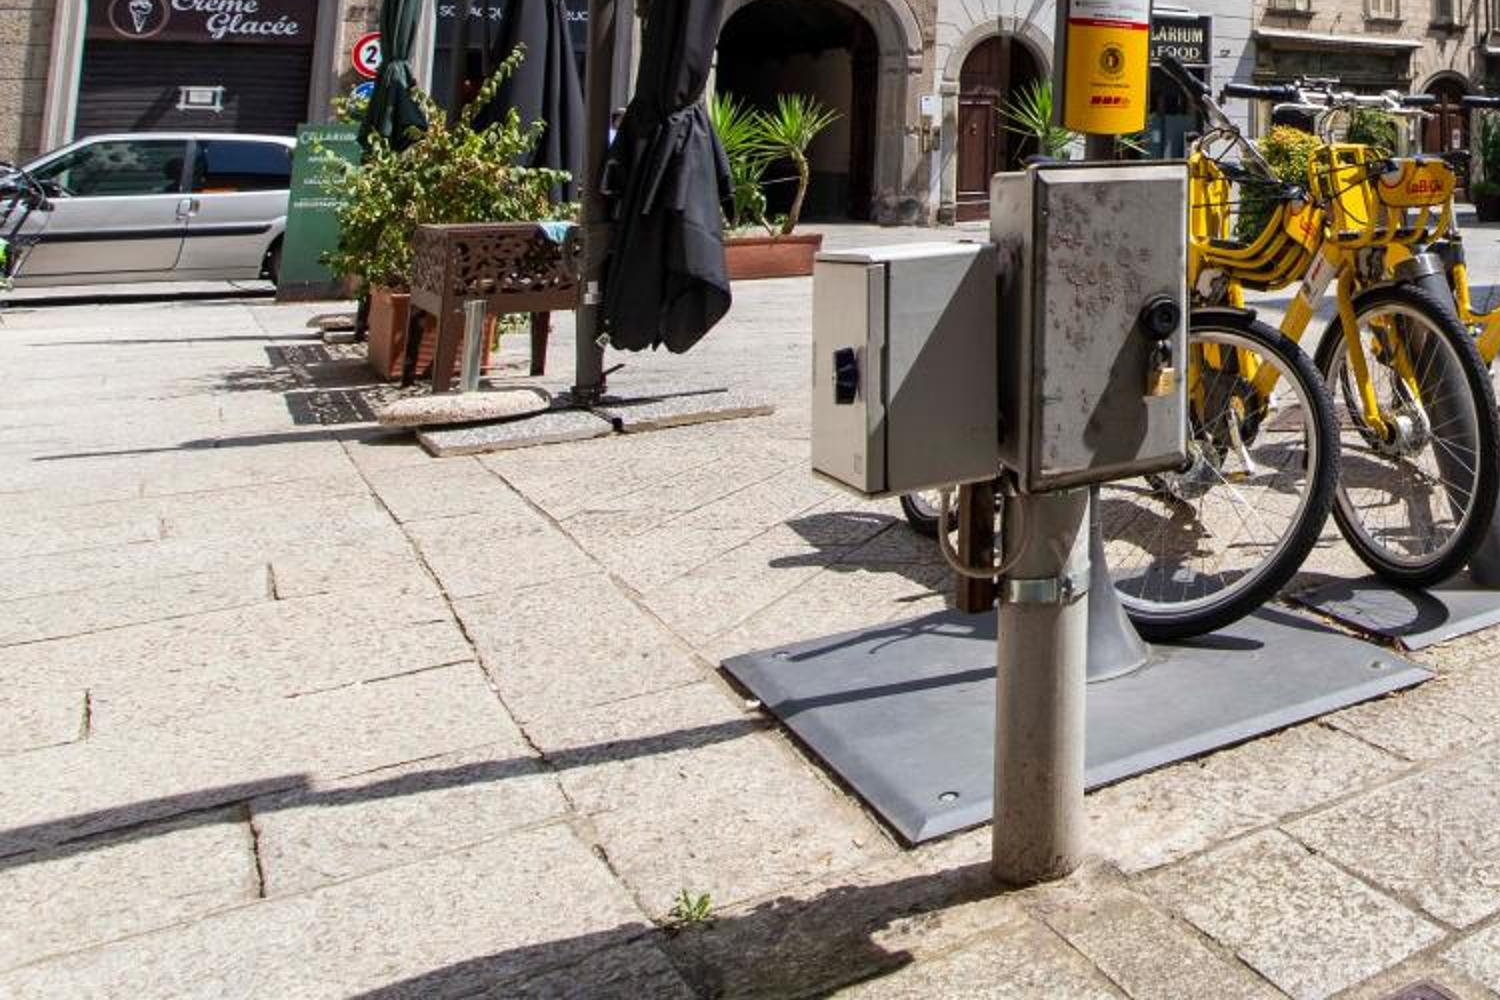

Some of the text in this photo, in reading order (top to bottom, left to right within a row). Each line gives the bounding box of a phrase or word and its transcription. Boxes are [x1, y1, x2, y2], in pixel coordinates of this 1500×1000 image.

[205, 12, 299, 40] Glacée
[1151, 25, 1203, 43] LARIUM
[1157, 45, 1201, 58] FOOD
